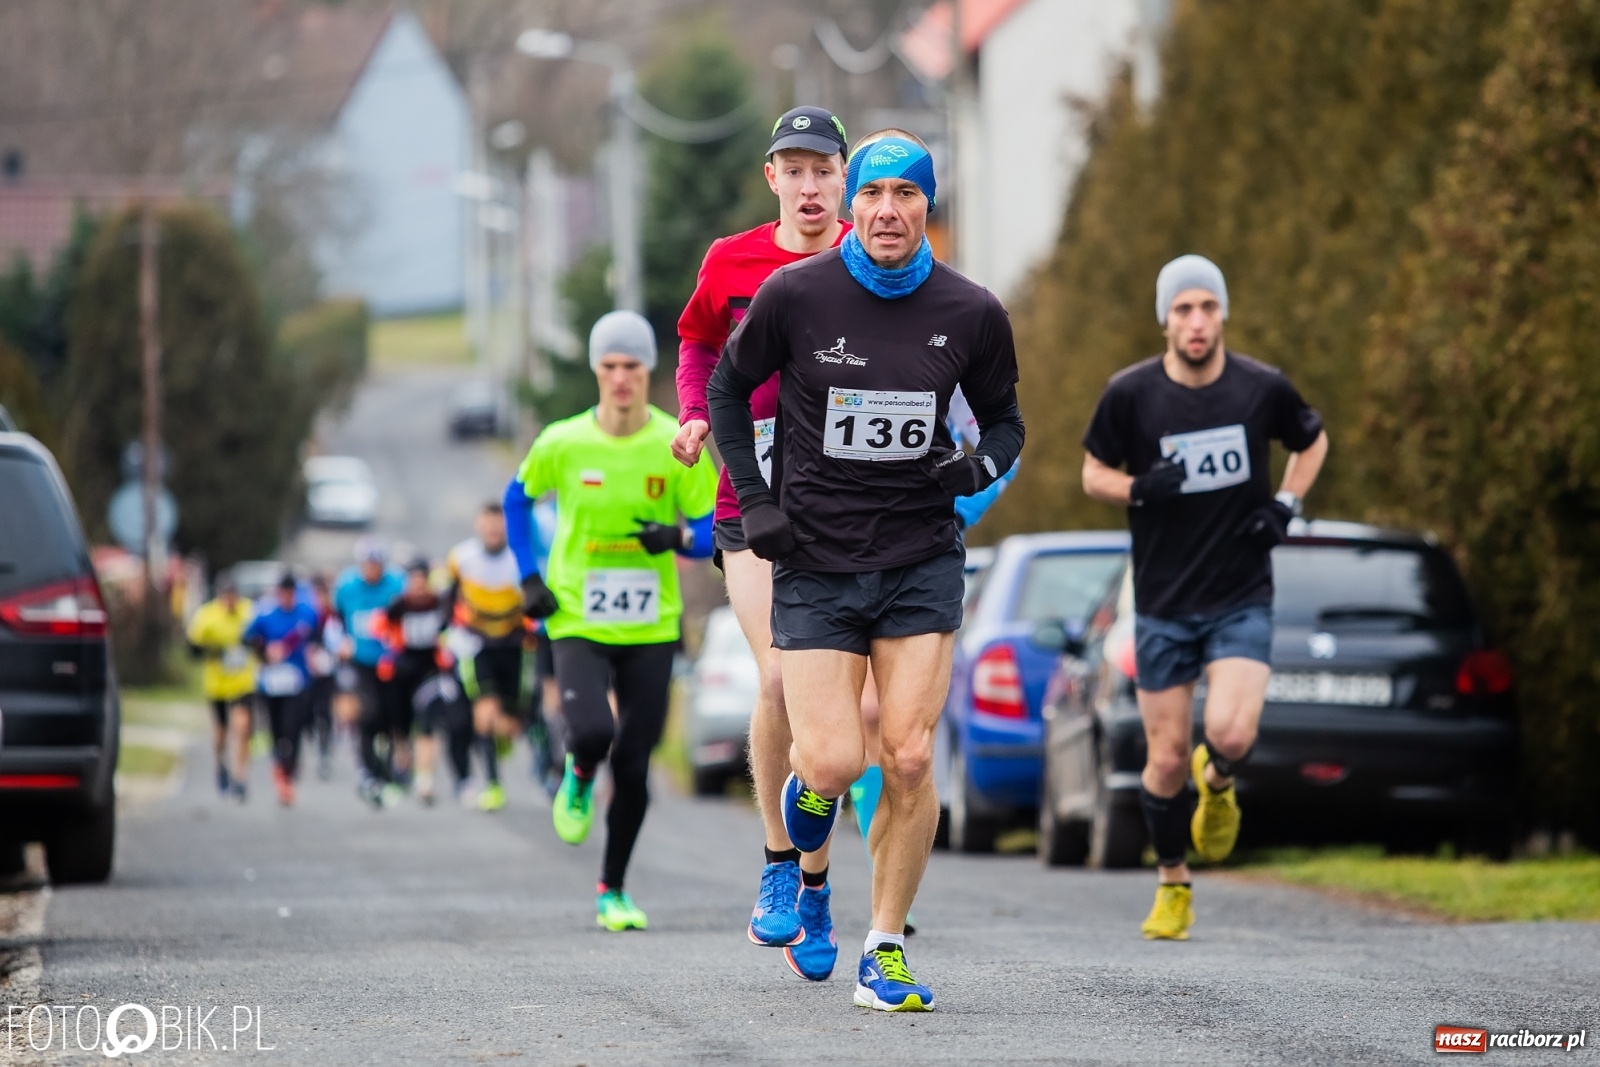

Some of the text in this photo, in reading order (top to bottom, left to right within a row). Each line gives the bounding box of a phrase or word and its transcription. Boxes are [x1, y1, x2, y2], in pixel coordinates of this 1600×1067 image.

[868, 399, 932, 408] www.personalbest.pl
[834, 415, 927, 449] 136
[590, 589, 652, 614] 247
